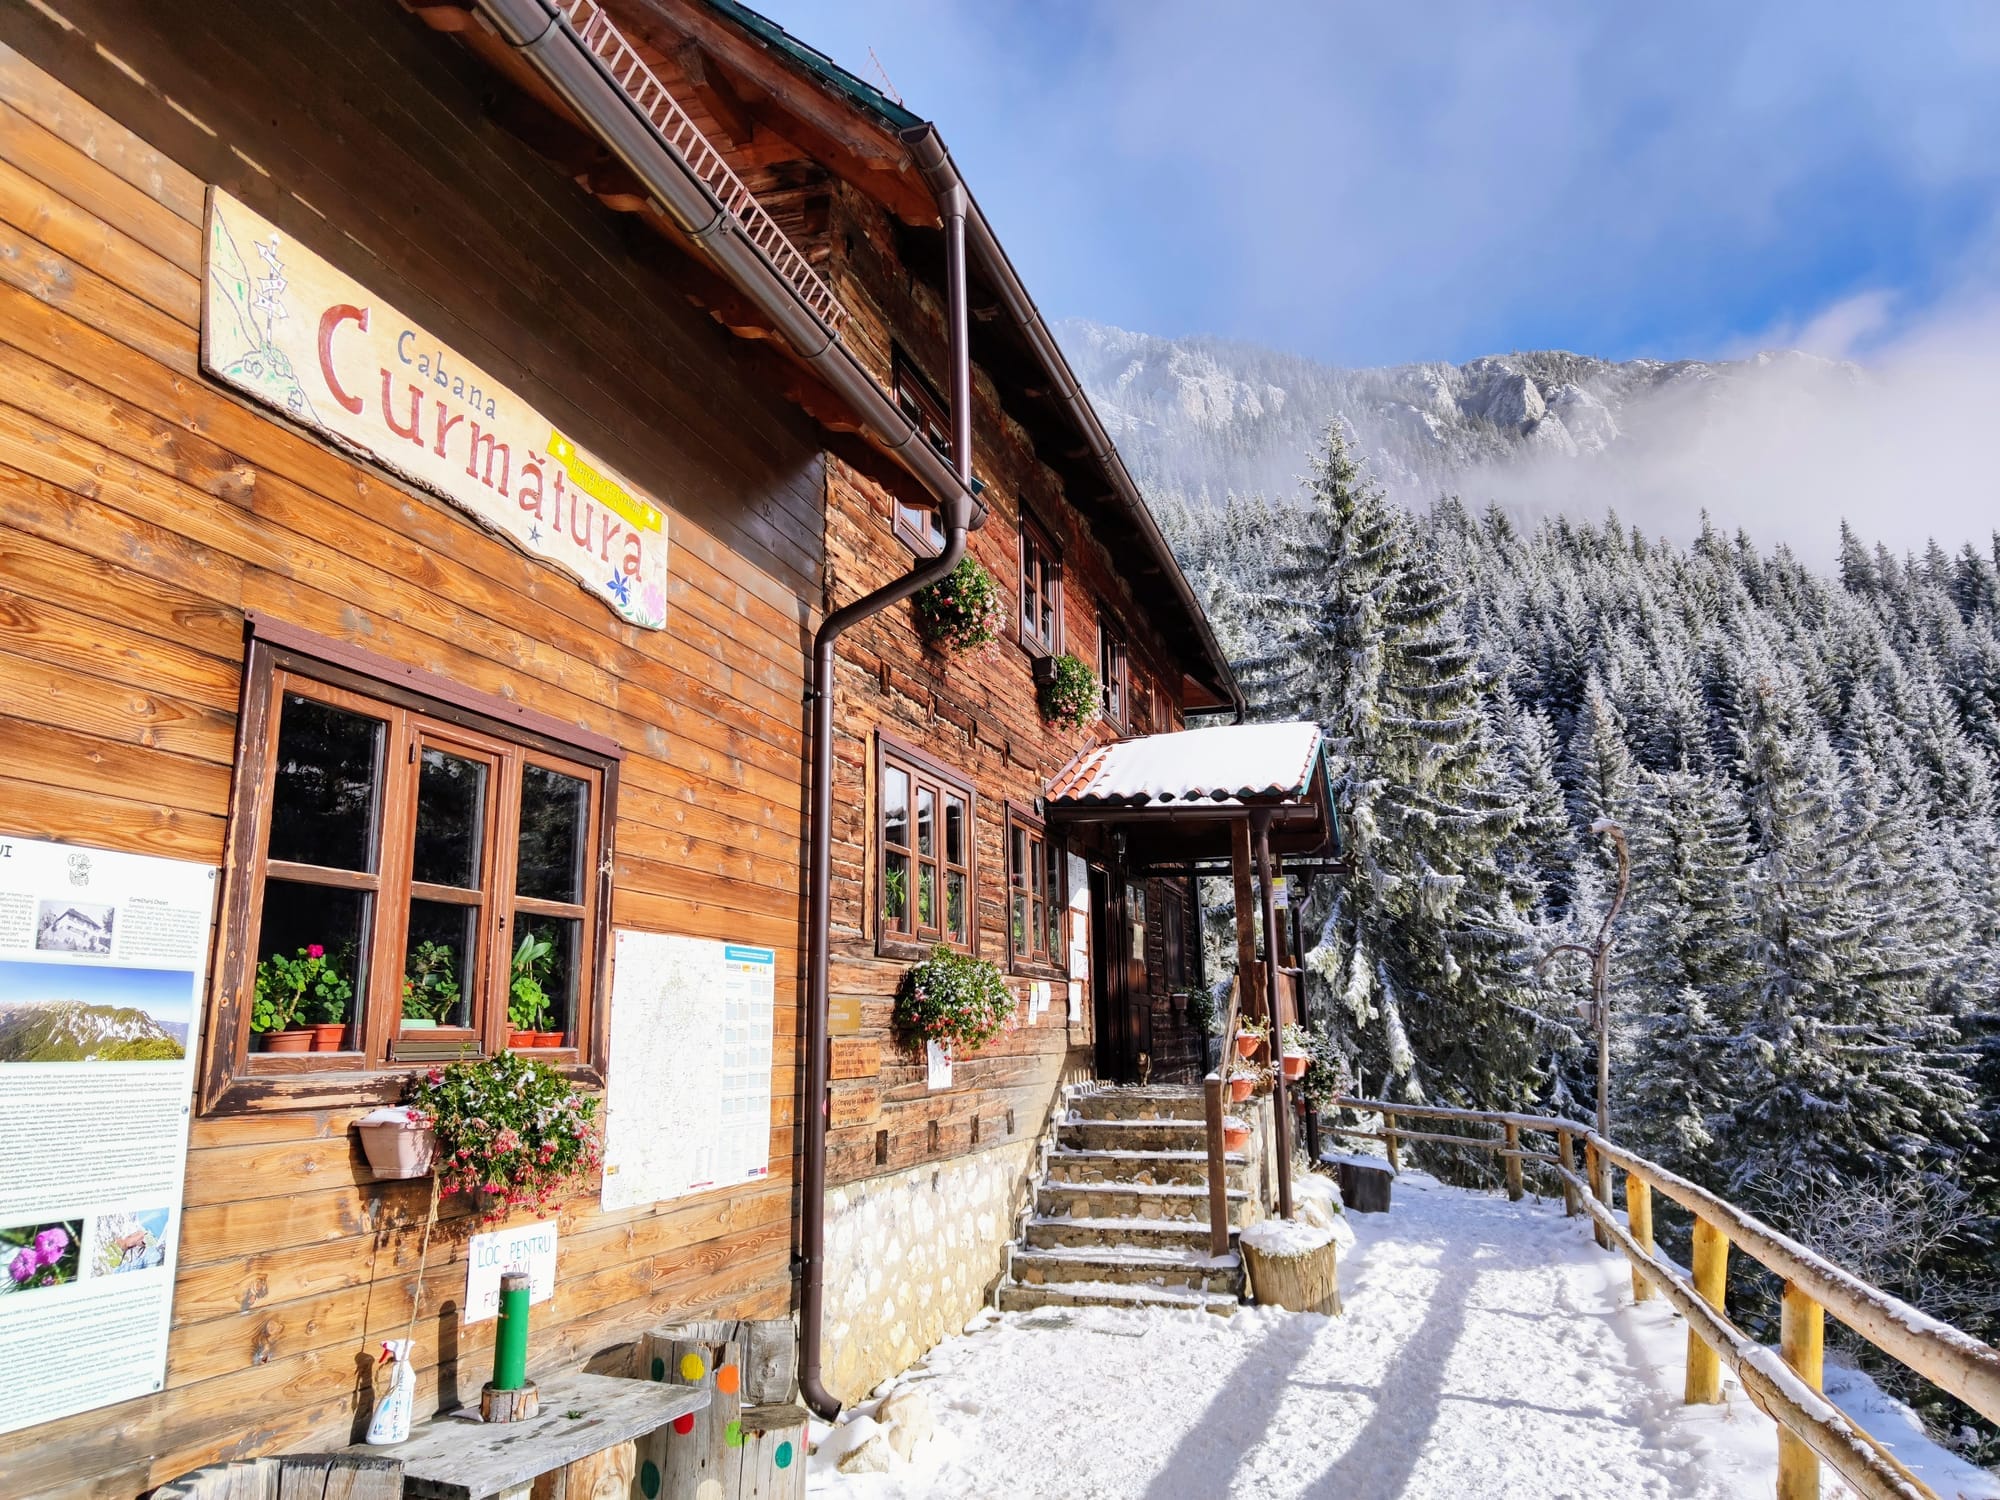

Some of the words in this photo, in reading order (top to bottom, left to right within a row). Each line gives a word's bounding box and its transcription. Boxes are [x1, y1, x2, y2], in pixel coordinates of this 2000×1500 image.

[396, 329, 497, 420] Cabana
[317, 303, 644, 584] Curmătura
[477, 1245, 501, 1268] LOC
[510, 1234, 551, 1260] PENTRU
